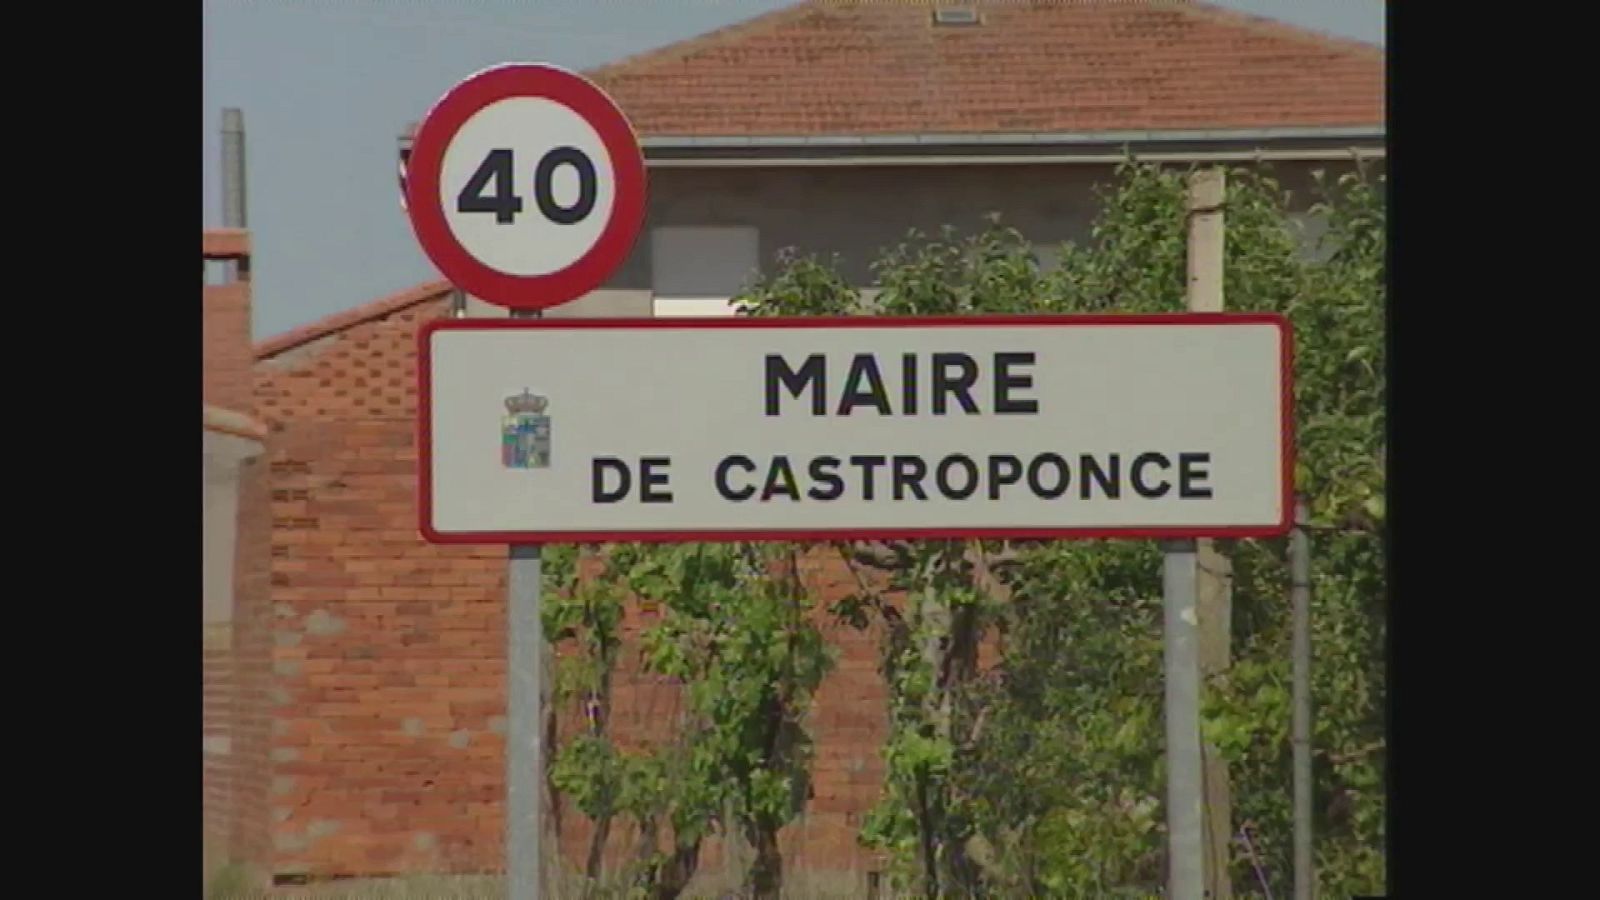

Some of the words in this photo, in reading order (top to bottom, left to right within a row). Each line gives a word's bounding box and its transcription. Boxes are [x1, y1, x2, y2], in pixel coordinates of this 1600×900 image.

[457, 146, 598, 226] 40
[764, 351, 1040, 416] MAIRE
[591, 456, 674, 504] DE
[714, 451, 1213, 503] CASTROPONCE
